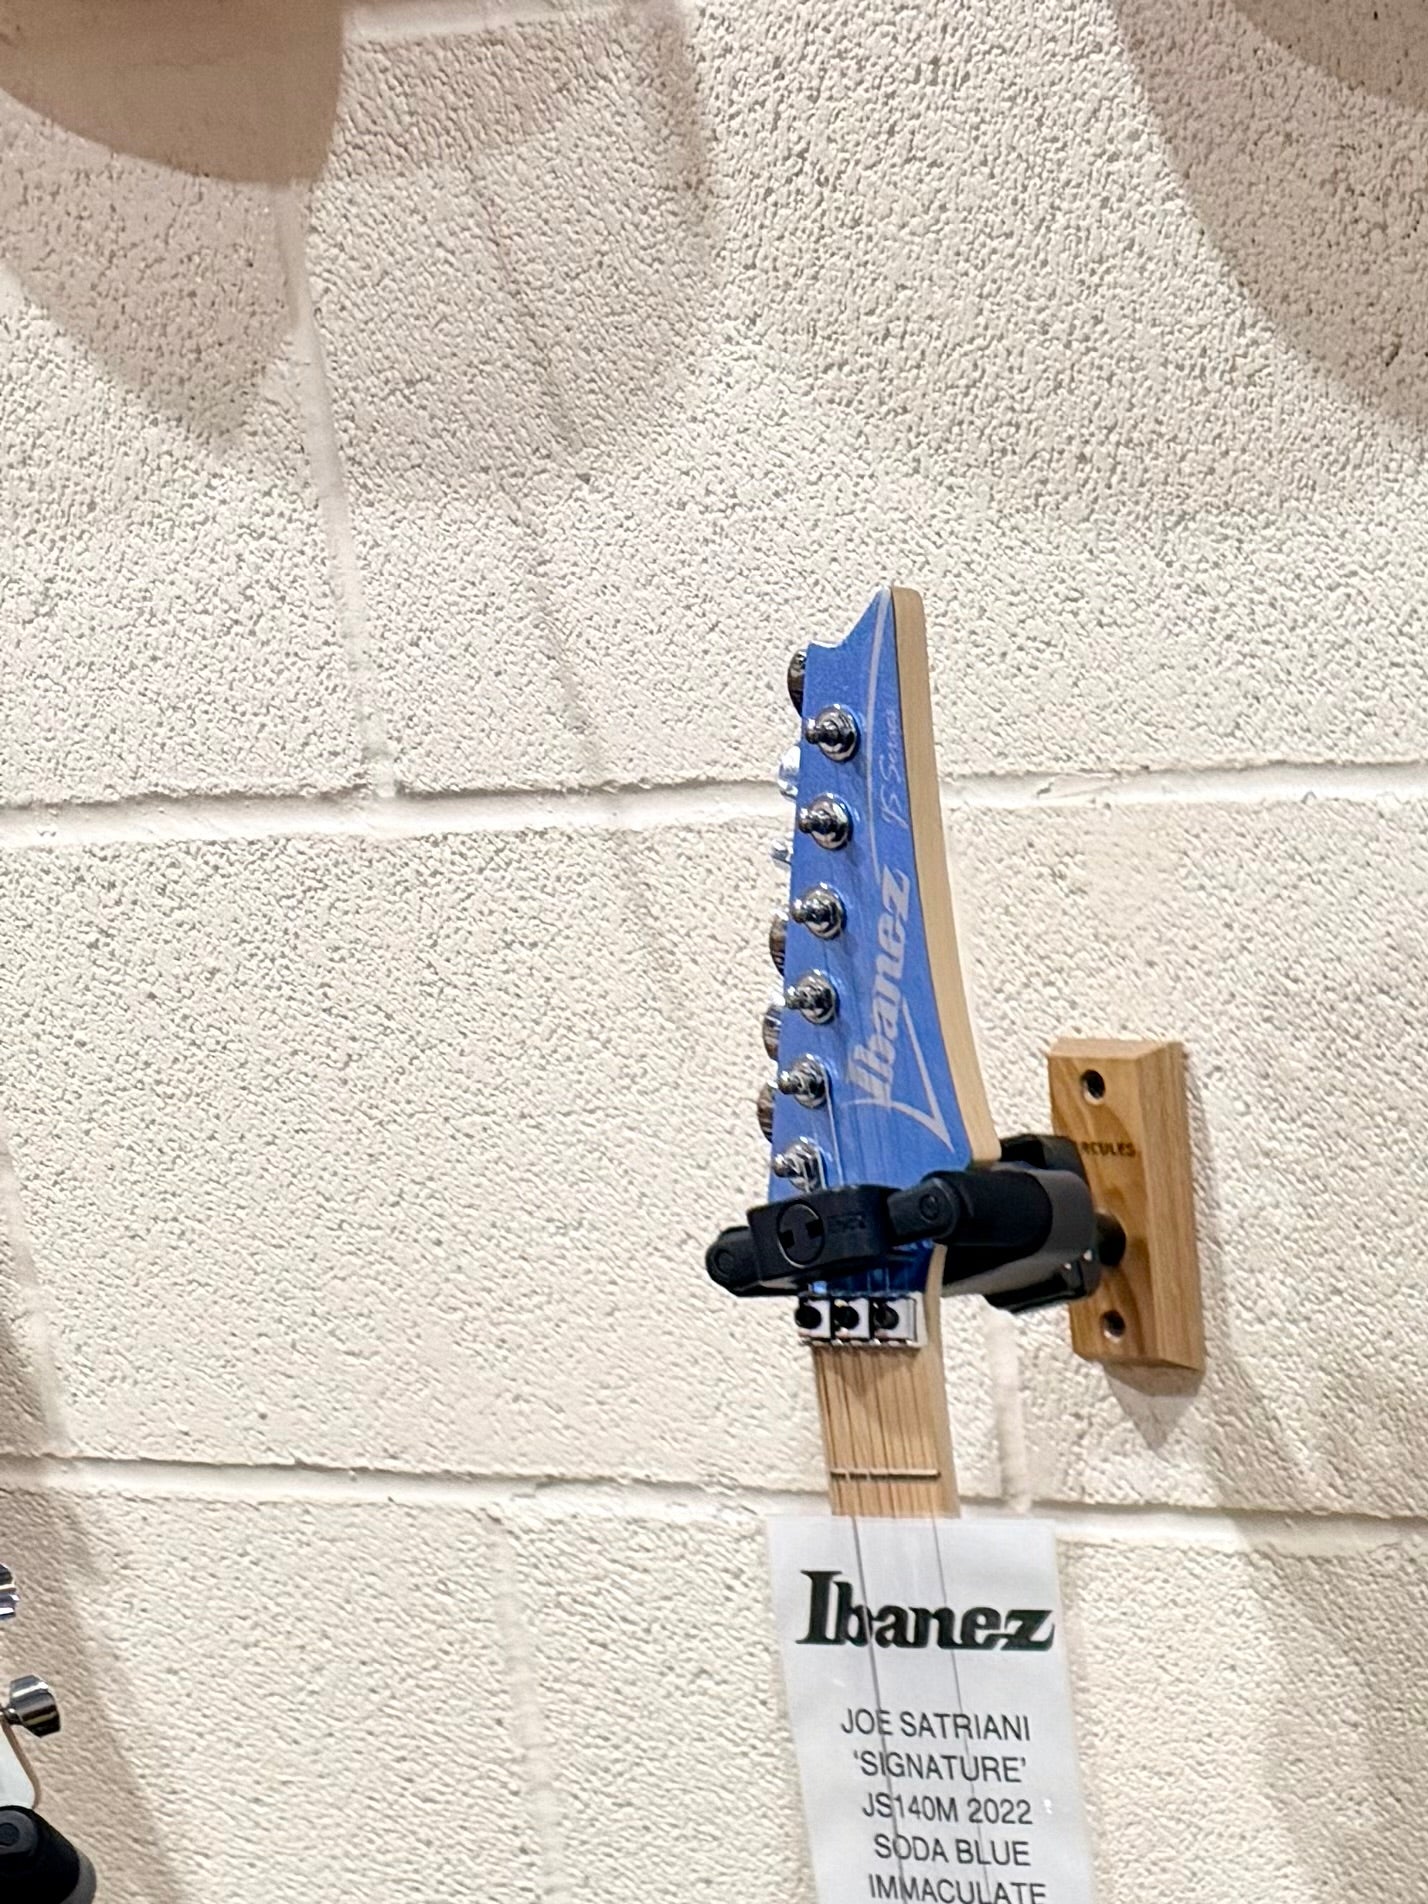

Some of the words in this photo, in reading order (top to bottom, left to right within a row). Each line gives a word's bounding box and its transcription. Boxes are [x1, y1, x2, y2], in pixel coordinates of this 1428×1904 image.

[848, 863, 910, 1109] Ibanez
[795, 1568, 1057, 1653] Ibanez
[840, 1708, 894, 1738] JOE
[900, 1710, 1032, 1743] SATRIANI
[861, 1793, 960, 1824] JS140M
[967, 1797, 1034, 1826] 2022
[873, 1834, 948, 1865] SODA
[956, 1837, 1032, 1868] BLUE
